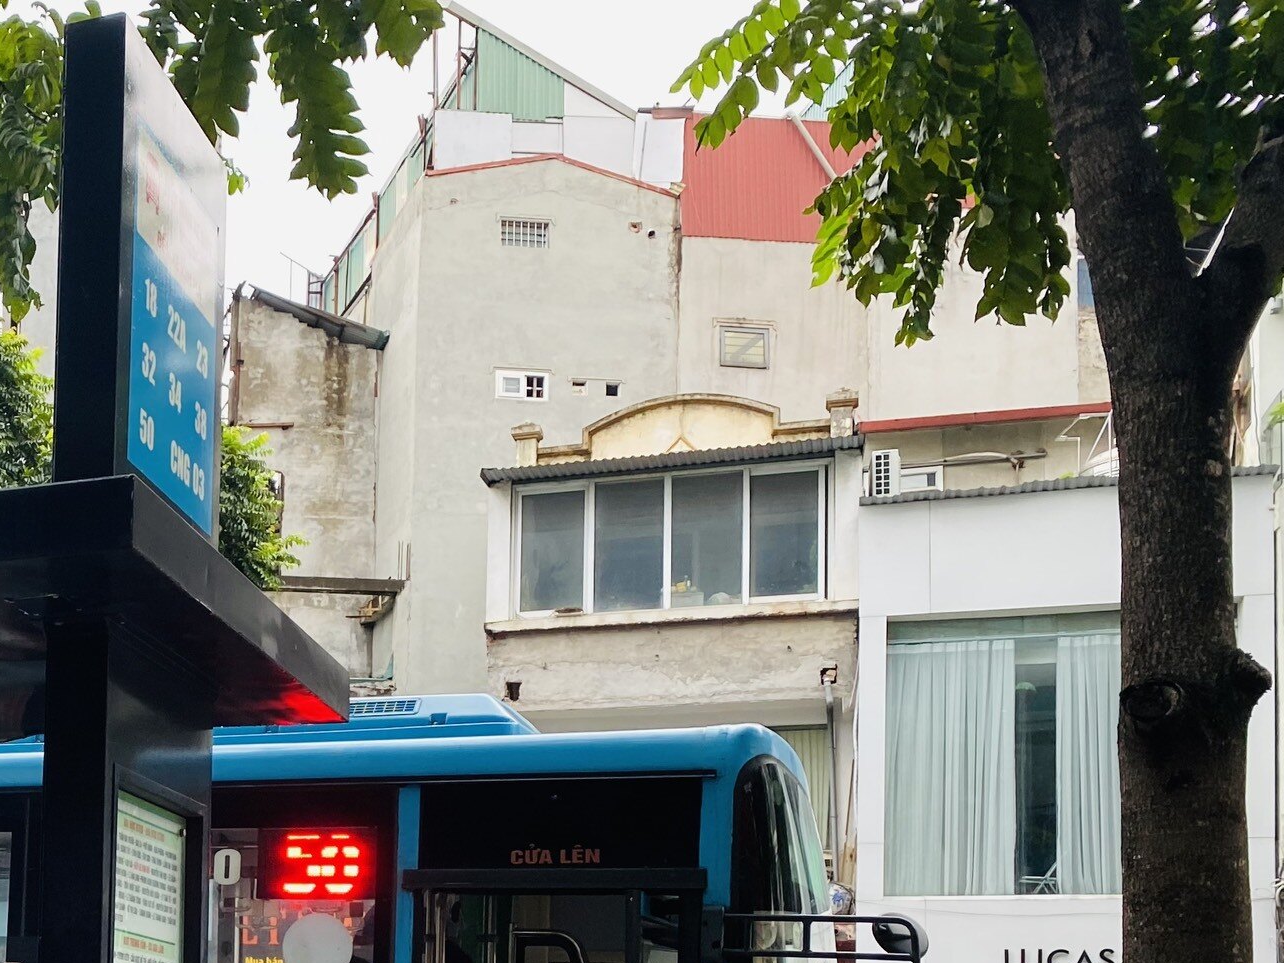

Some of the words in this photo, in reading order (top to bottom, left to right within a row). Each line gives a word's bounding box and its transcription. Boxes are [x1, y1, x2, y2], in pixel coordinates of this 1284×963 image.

[144, 278, 158, 318] 18
[167, 304, 186, 355] 22A
[196, 339, 209, 379] 23
[141, 342, 157, 387] 32
[168, 372, 182, 414] 34
[194, 401, 208, 441] 38
[139, 407, 155, 452] 50
[170, 439, 191, 488] CNG
[192, 462, 206, 502] 03
[213, 848, 242, 886] 0
[510, 843, 553, 865] CỬA
[559, 844, 601, 864] LÊN
